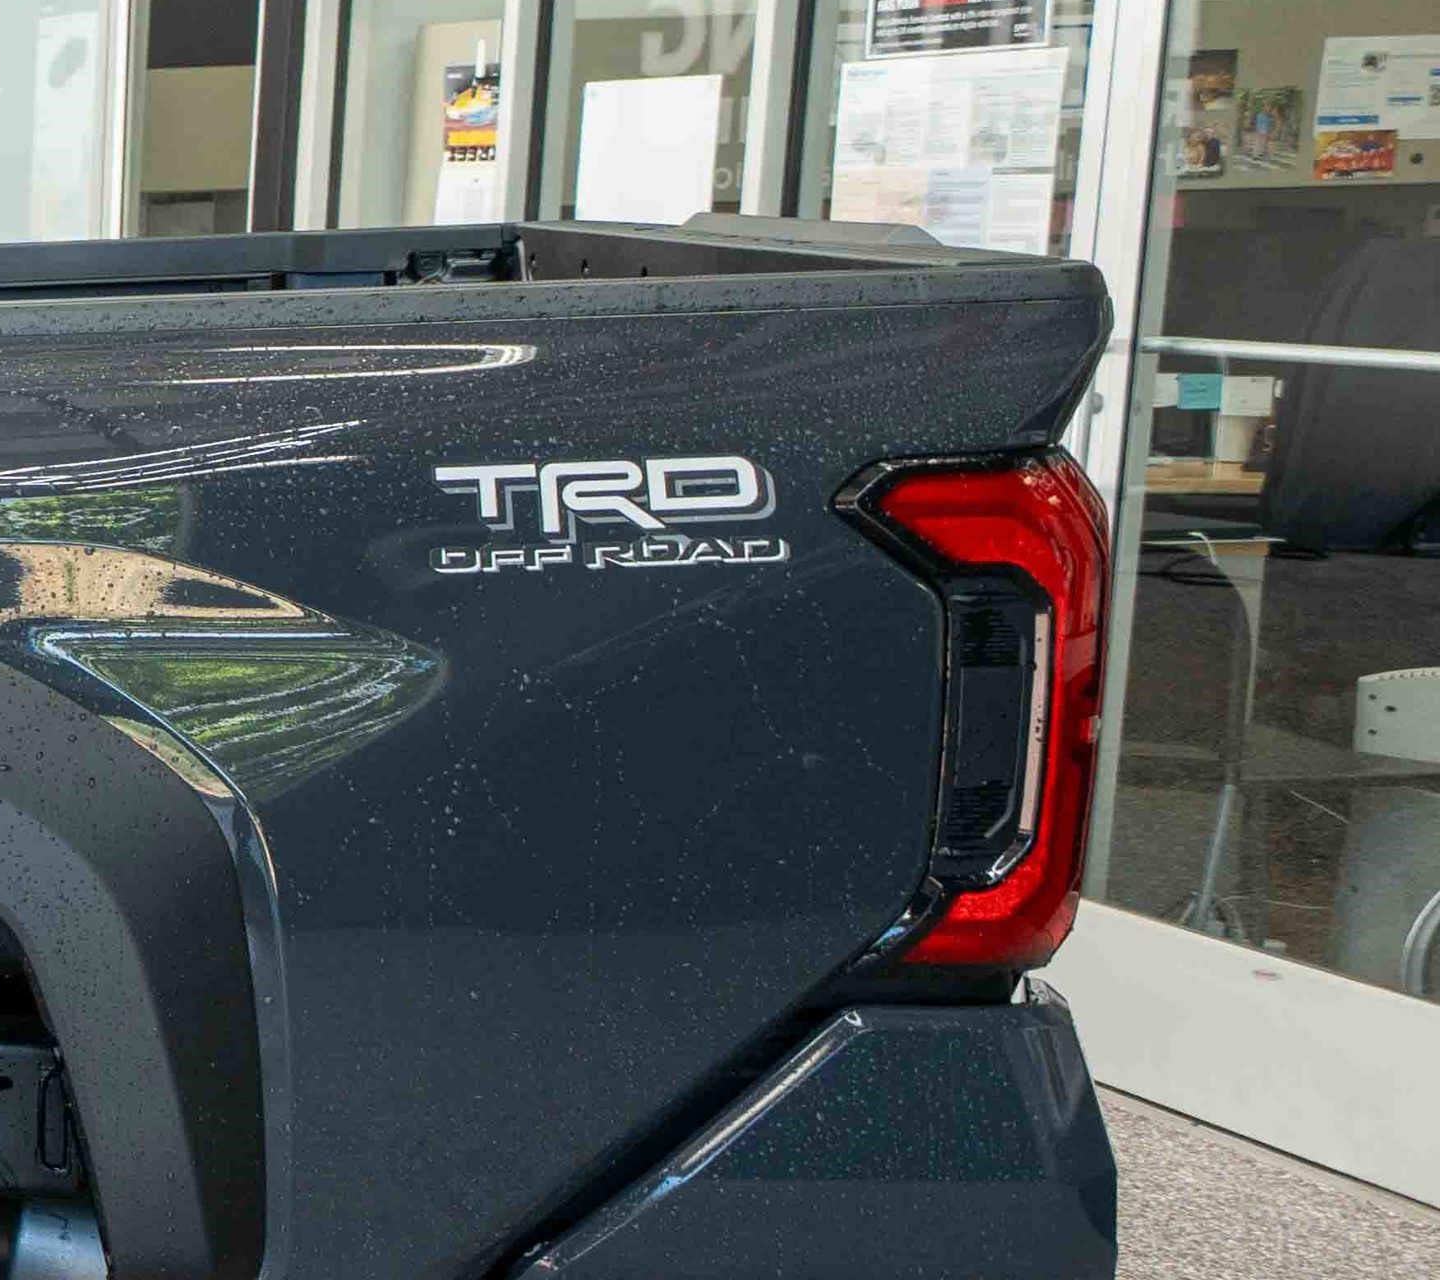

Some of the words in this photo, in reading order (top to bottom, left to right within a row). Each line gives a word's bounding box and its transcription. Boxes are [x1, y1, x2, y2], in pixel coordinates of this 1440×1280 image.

[434, 455, 770, 538] TRD
[430, 543, 573, 574] OFF
[584, 535, 792, 570] ROAD
